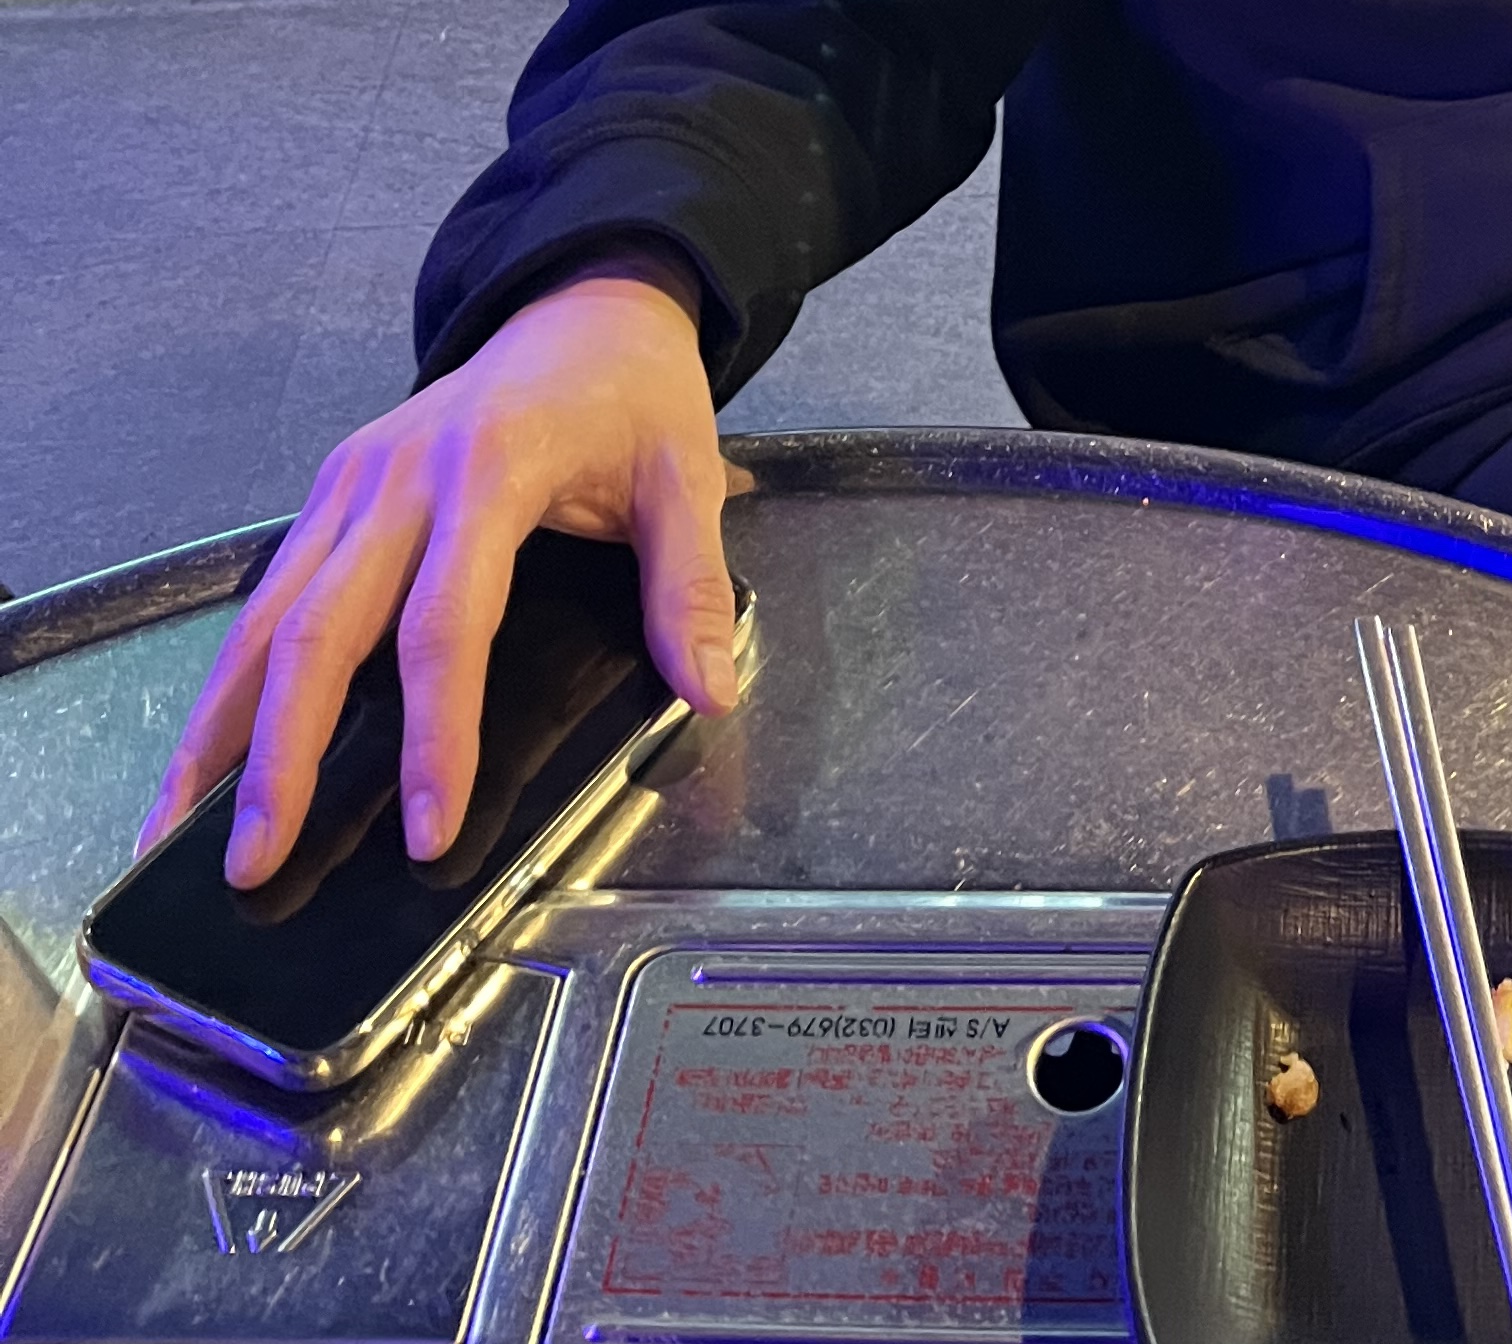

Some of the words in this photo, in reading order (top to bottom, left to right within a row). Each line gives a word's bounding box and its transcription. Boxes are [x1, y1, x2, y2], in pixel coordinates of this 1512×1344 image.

[702, 1015, 896, 1039] (032)679-3707
[907, 1016, 961, 1039] 센터
[967, 1016, 1010, 1038] A/S
